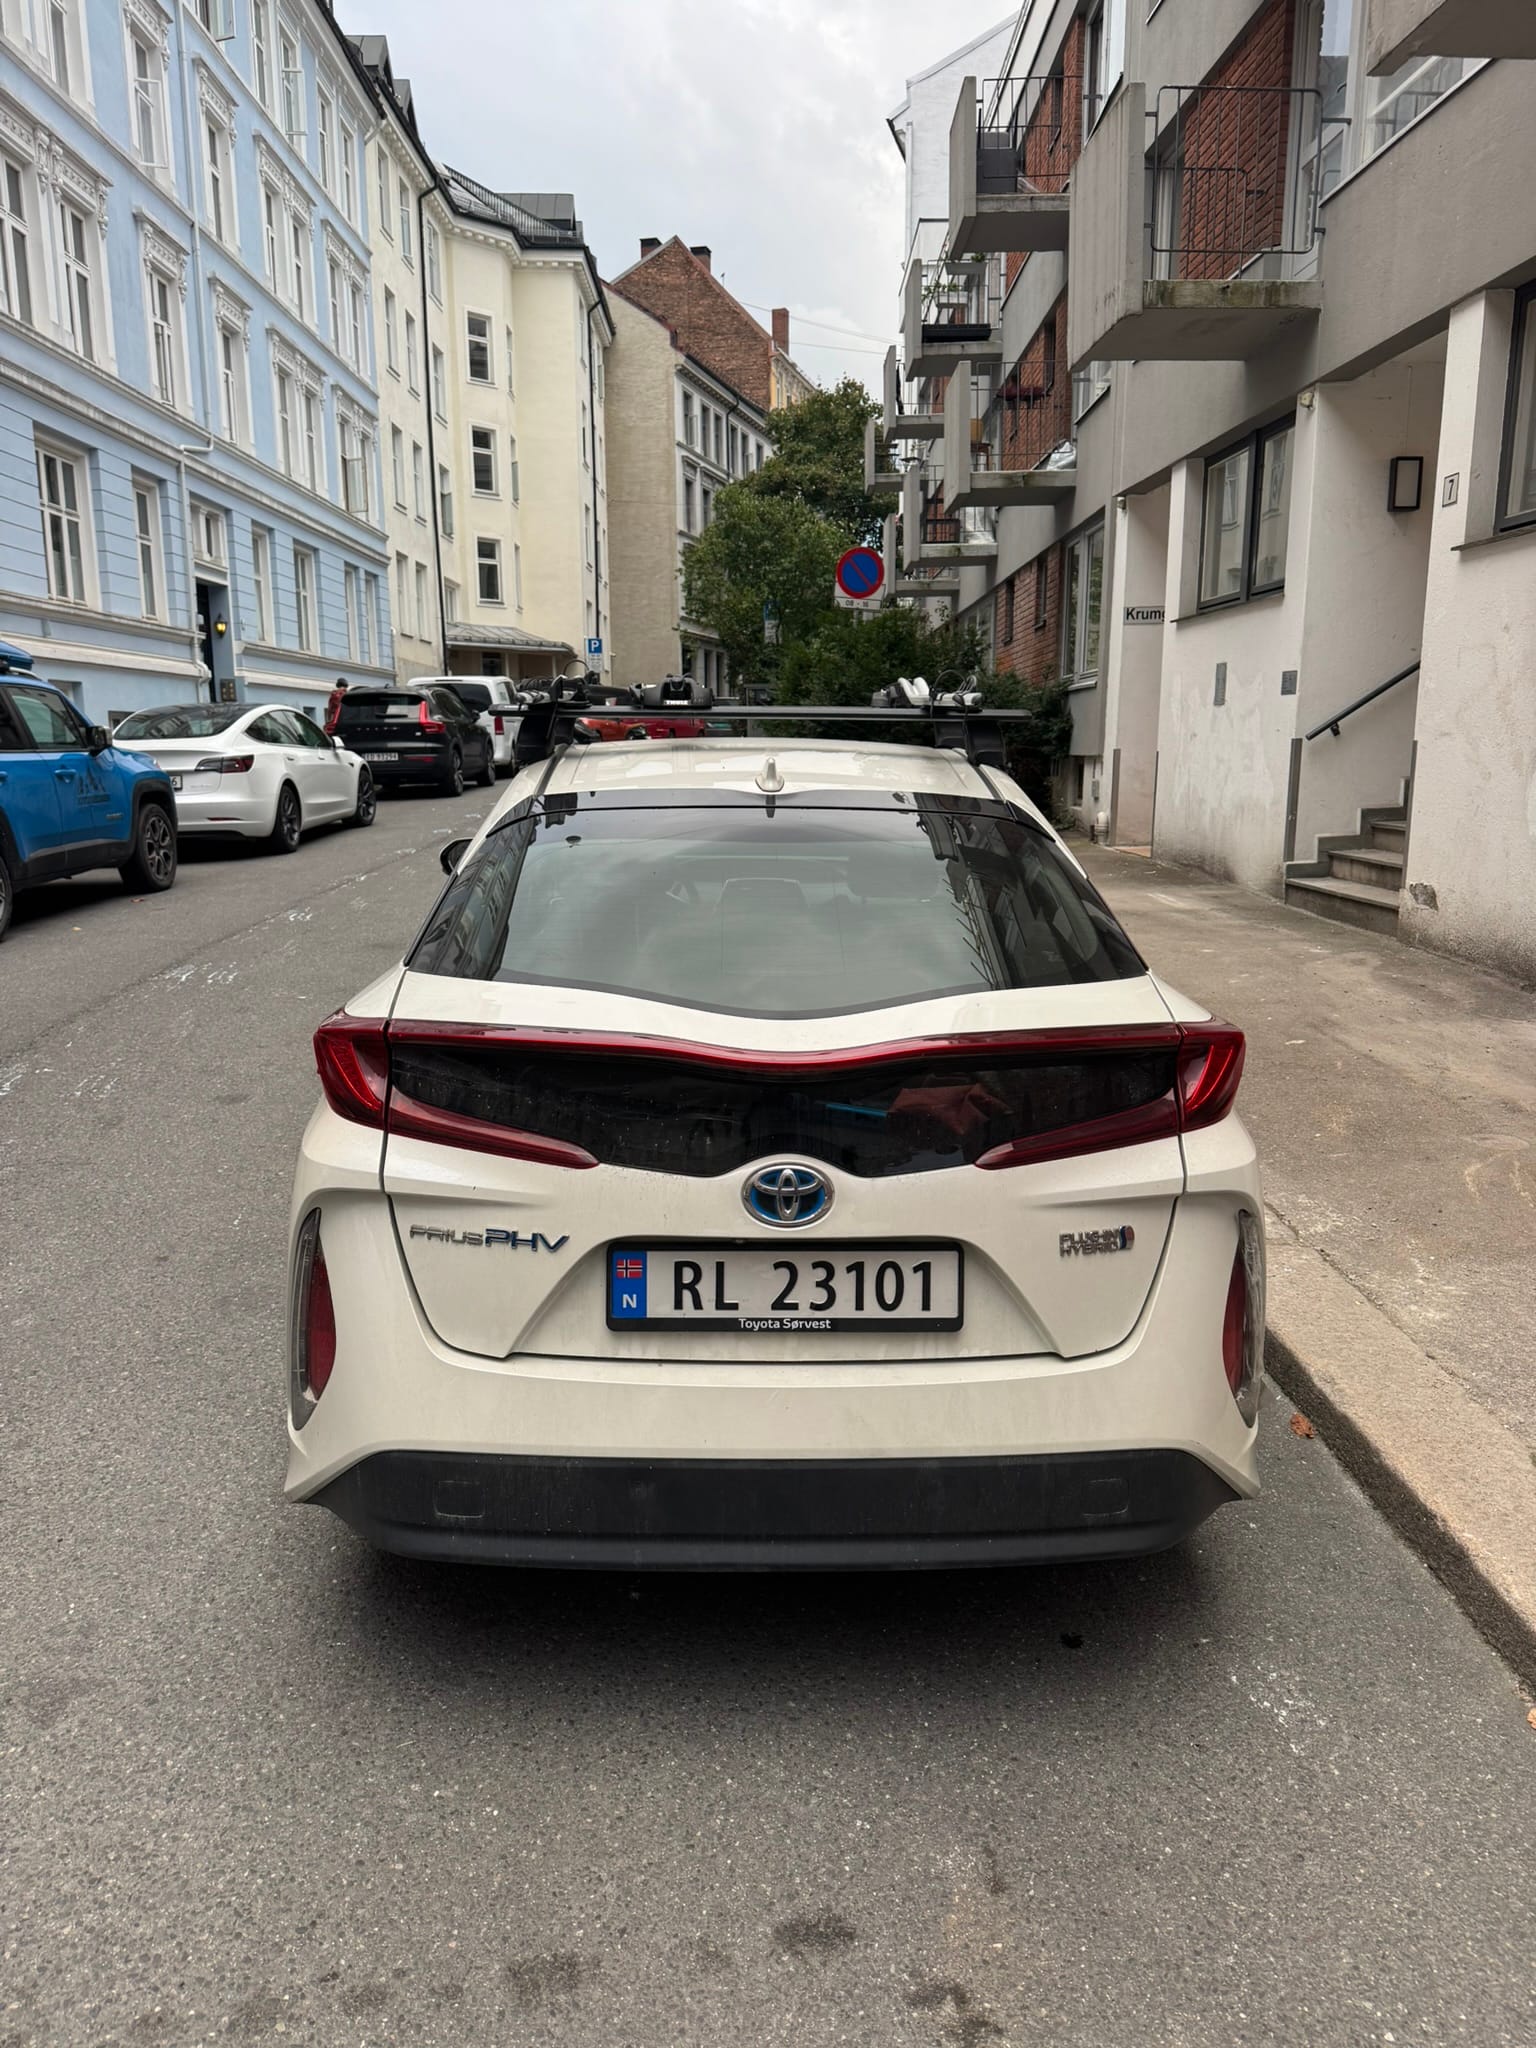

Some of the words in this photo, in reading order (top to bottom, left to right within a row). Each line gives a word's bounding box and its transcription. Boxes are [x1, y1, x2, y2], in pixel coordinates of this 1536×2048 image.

[1448, 479, 1455, 500] 7
[591, 640, 600, 652] P
[673, 1260, 739, 1311] RL
[770, 1260, 932, 1312] 23101
[622, 1294, 637, 1309] N
[738, 1318, 780, 1331] Toyota
[783, 1318, 831, 1329] Sørvest
